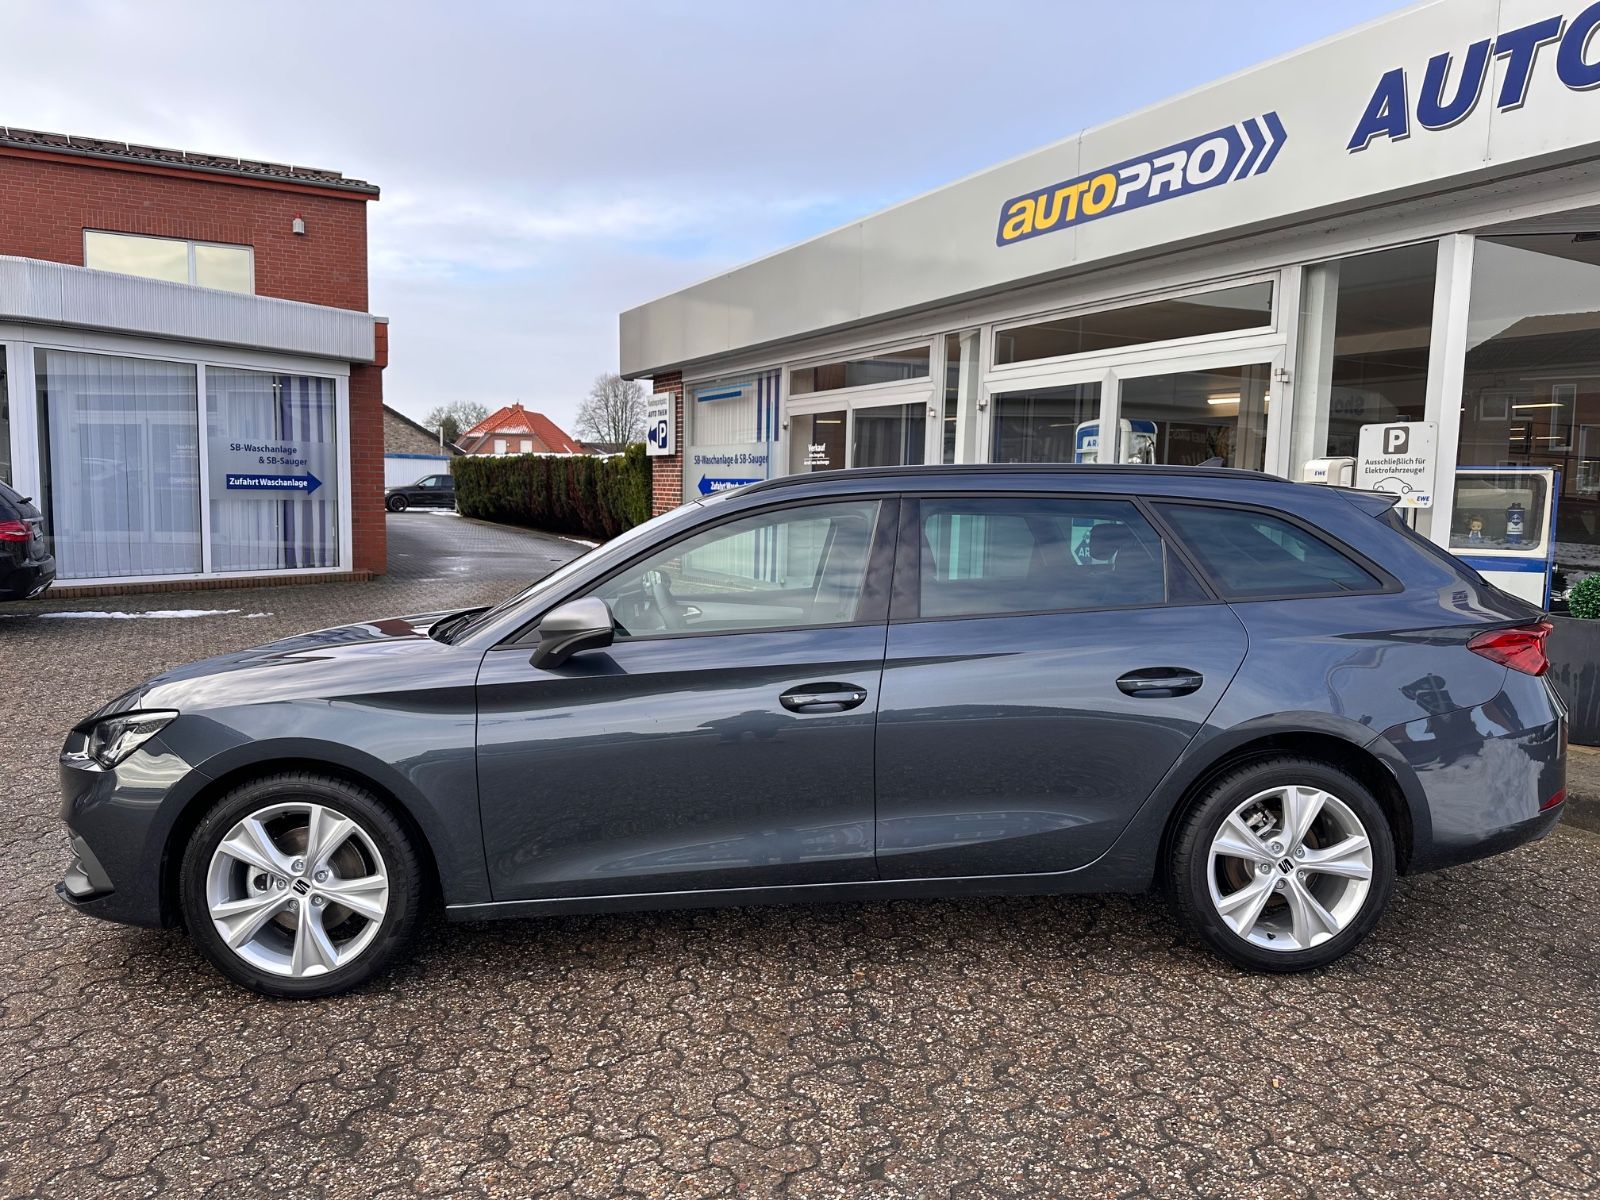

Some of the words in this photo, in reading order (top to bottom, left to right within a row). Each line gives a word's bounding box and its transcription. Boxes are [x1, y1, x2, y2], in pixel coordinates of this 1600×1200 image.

[1388, 429, 1406, 453] P
[230, 443, 297, 455] SB-Waschanlage
[808, 443, 826, 452] Verkauf
[259, 456, 265, 464] &
[266, 456, 308, 467] SB-Sauger
[694, 454, 734, 467] SB-Waschanlage
[734, 454, 739, 464] &
[1364, 458, 1414, 466] Ausschließlich
[1414, 457, 1426, 465] für
[1364, 466, 1425, 475] Elektrofahrzeuge!
[229, 477, 259, 486] Zufahrt
[260, 478, 308, 488] Waschanlage
